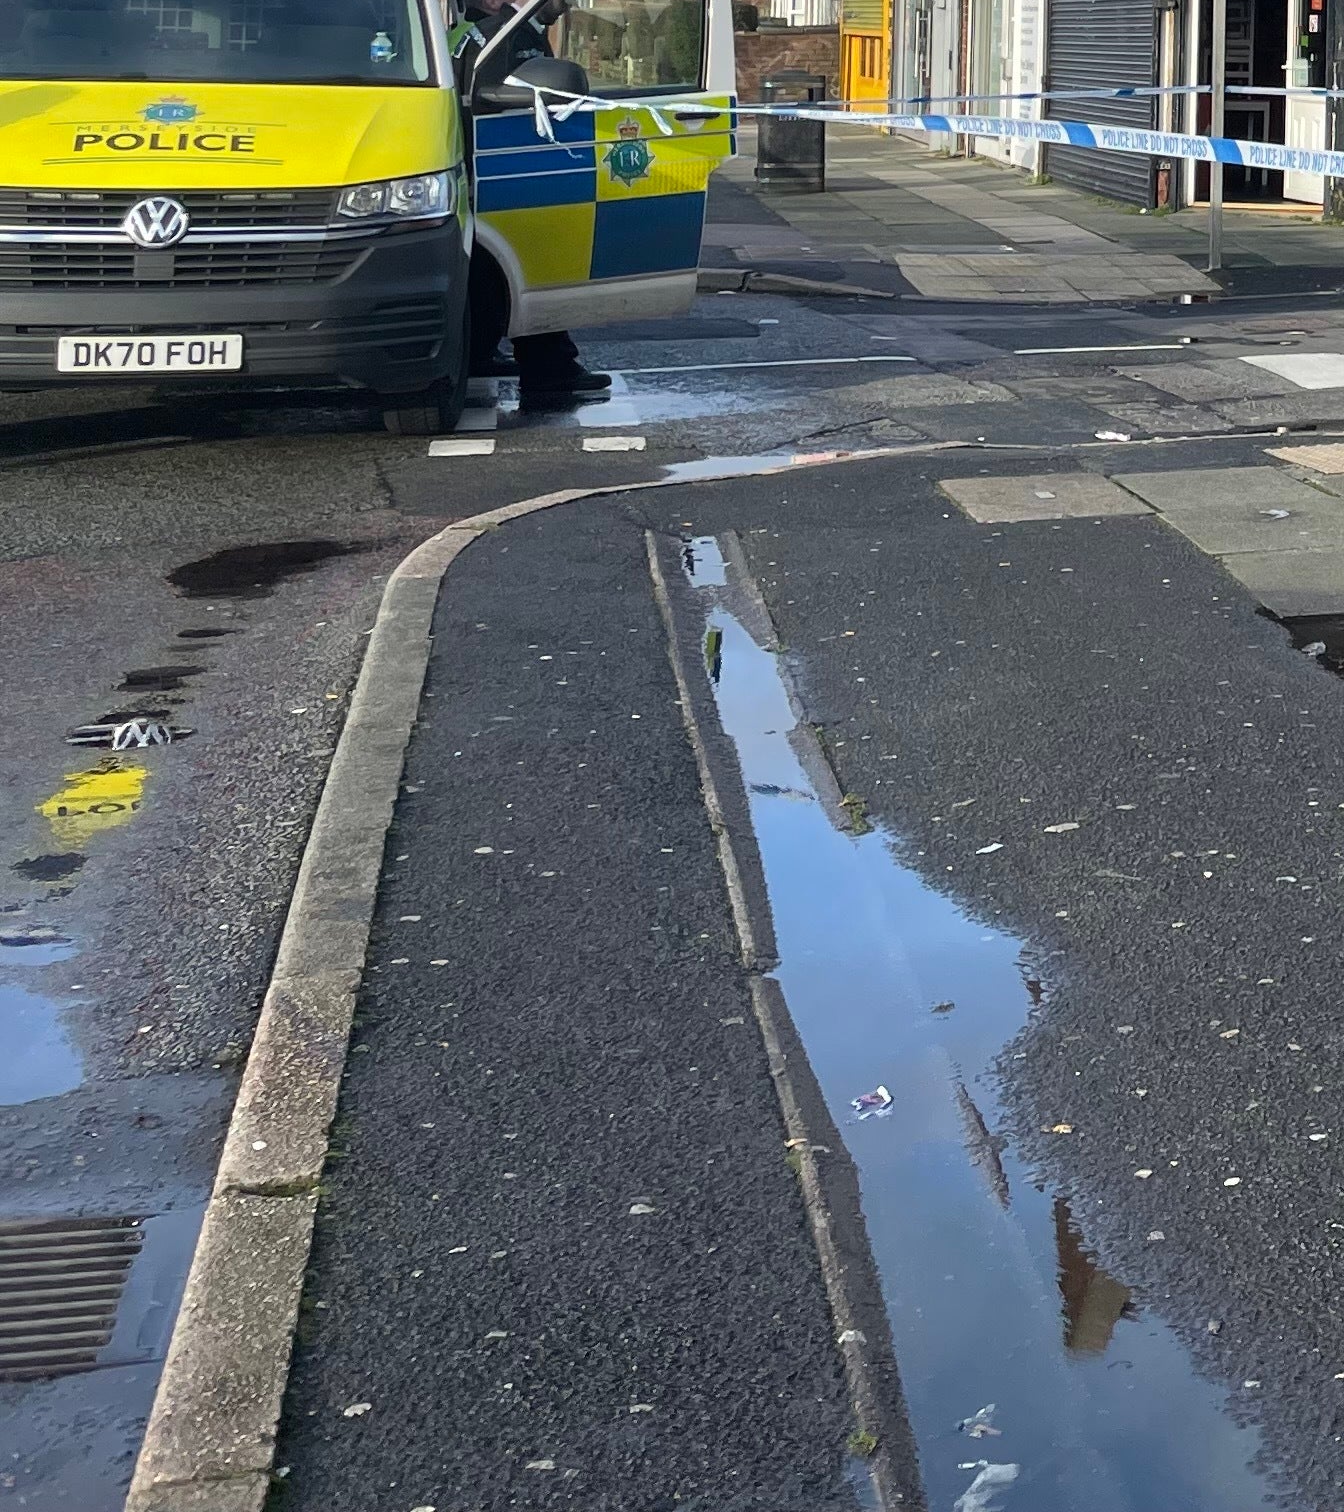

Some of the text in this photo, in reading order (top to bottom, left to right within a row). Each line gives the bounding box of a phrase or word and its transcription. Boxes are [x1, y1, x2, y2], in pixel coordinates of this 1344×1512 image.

[77, 124, 256, 133] MERSEYSIDE
[73, 133, 256, 152] POLICE
[1102, 129, 1207, 157] POLICE LINE DO NOT CROSS
[1249, 145, 1277, 166] POLICE
[1280, 149, 1296, 168] LINE
[1299, 151, 1310, 170] DO
[1312, 152, 1328, 172] NOT
[73, 341, 227, 366] DK70 FOH
